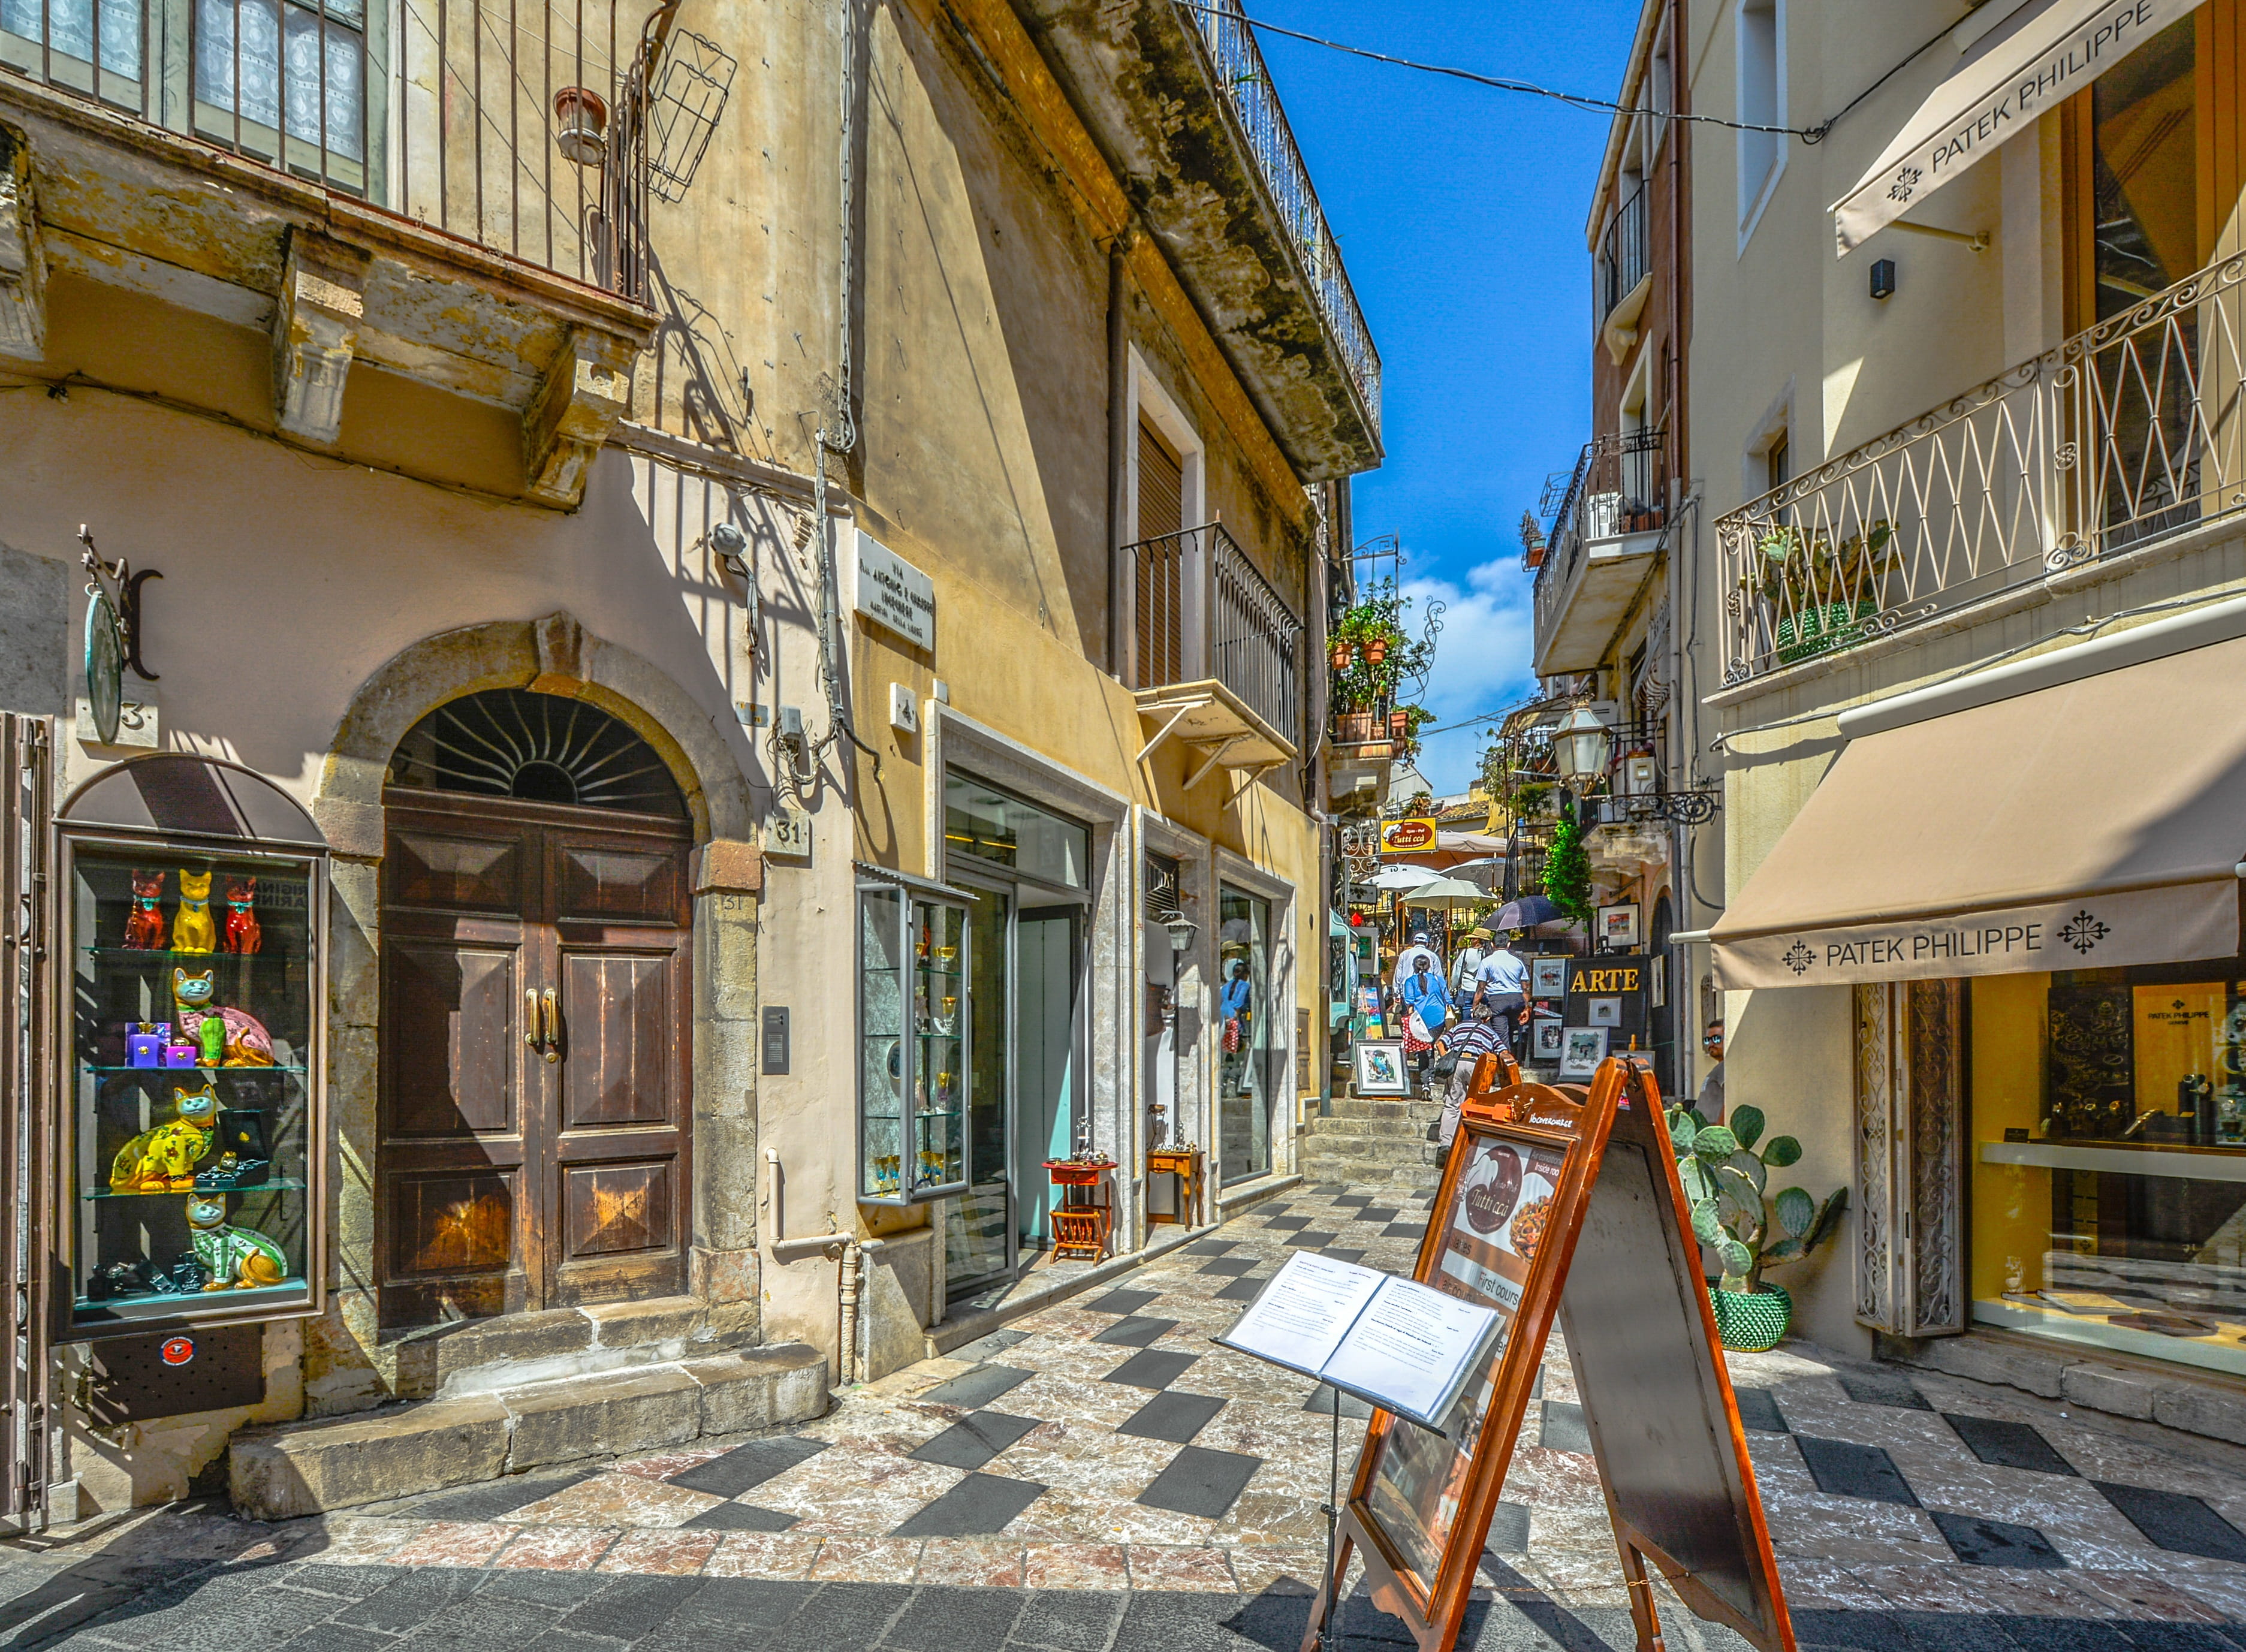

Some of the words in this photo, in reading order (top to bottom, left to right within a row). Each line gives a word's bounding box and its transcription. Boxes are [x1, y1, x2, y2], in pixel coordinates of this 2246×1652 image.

[1931, 97, 2012, 174] PATEK
[2019, 0, 2154, 111] PHILIPPE
[891, 561, 904, 580] VIA
[873, 568, 903, 597] ANTONIO
[904, 587, 909, 602] E
[910, 591, 933, 617] GIUSEPPE
[902, 699, 912, 724] 4
[778, 820, 800, 844] 31
[1392, 835, 1412, 843] Tutti
[723, 893, 743, 911] 31
[1826, 937, 1906, 967] PATEK
[1913, 924, 2043, 960] PHILIPPE
[1569, 968, 1639, 993] ARTE
[1534, 1162, 1550, 1174] Inside
[1549, 1168, 1560, 1176] roo
[1539, 1152, 1563, 1166] conditione
[1472, 1189, 1496, 1211] Tutti
[1478, 1271, 1496, 1293] First
